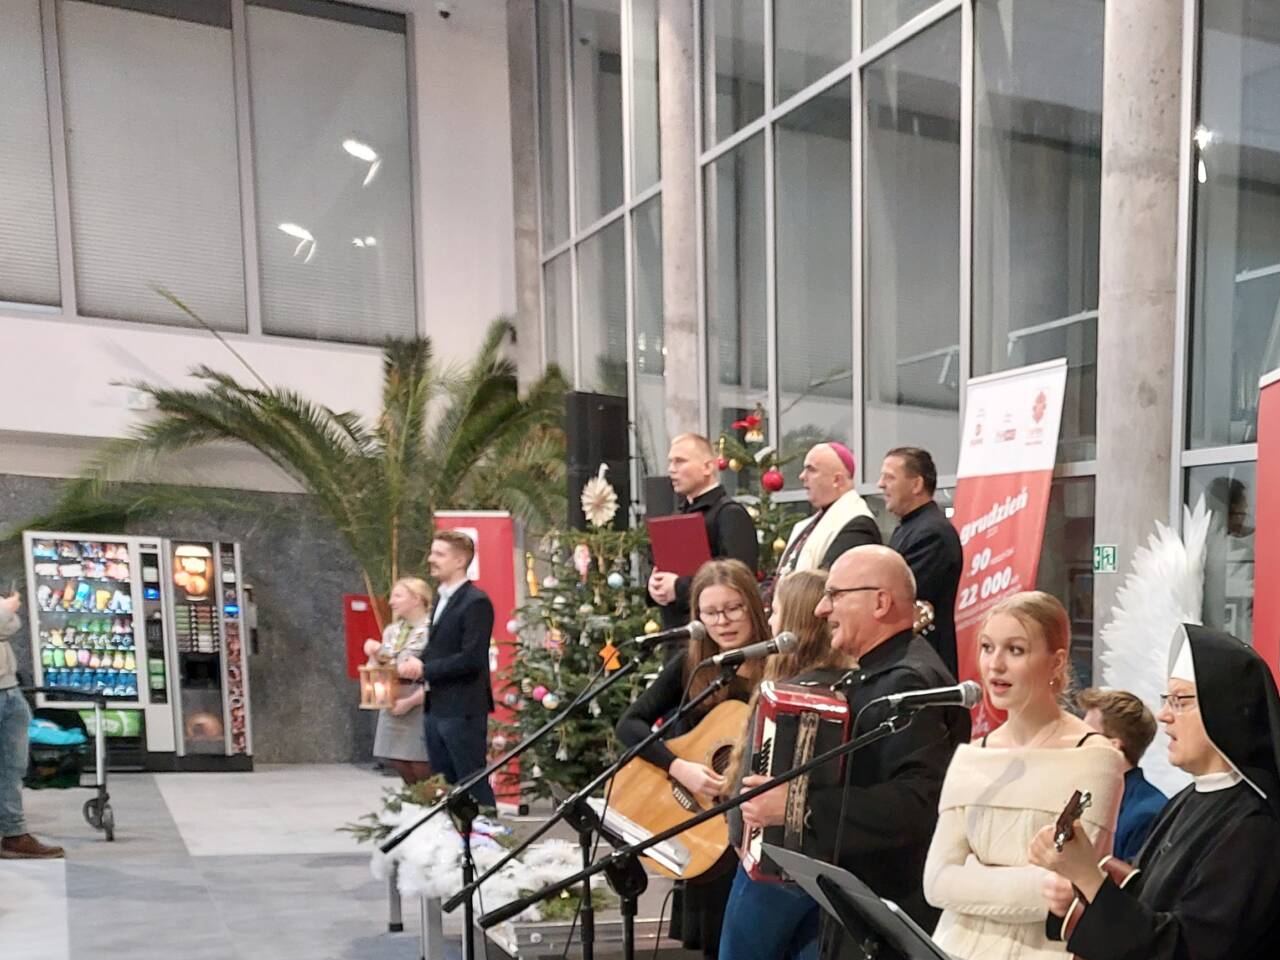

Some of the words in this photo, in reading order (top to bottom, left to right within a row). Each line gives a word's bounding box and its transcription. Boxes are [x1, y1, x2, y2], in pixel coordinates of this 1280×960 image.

[959, 486, 1029, 545] grudzień
[971, 547, 992, 576] 90
[958, 583, 979, 610] 22
[980, 566, 1013, 599] 000
